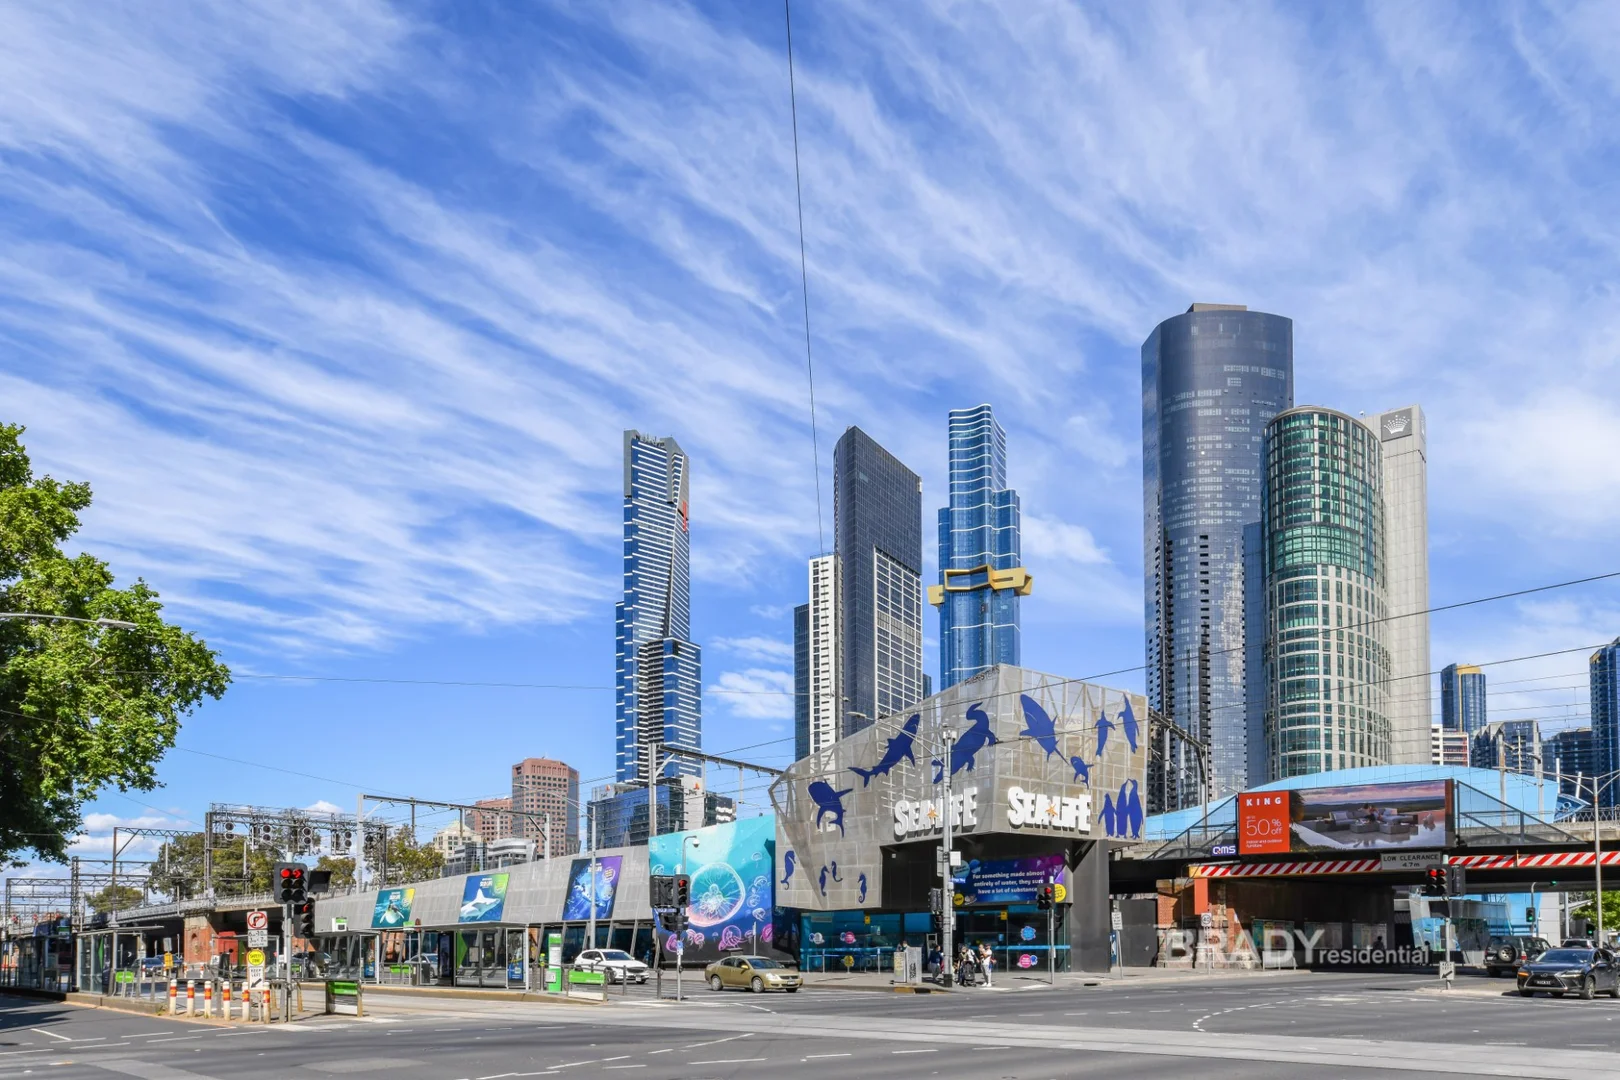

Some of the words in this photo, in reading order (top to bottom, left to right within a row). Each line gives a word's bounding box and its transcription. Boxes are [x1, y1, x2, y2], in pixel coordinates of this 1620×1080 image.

[1246, 797, 1281, 806] KING
[895, 800, 935, 836] SEA
[935, 787, 977, 829] LFE
[1007, 786, 1051, 825] SEA
[1052, 793, 1091, 832] LIFE
[1271, 827, 1282, 835] off
[982, 871, 1010, 879] something
